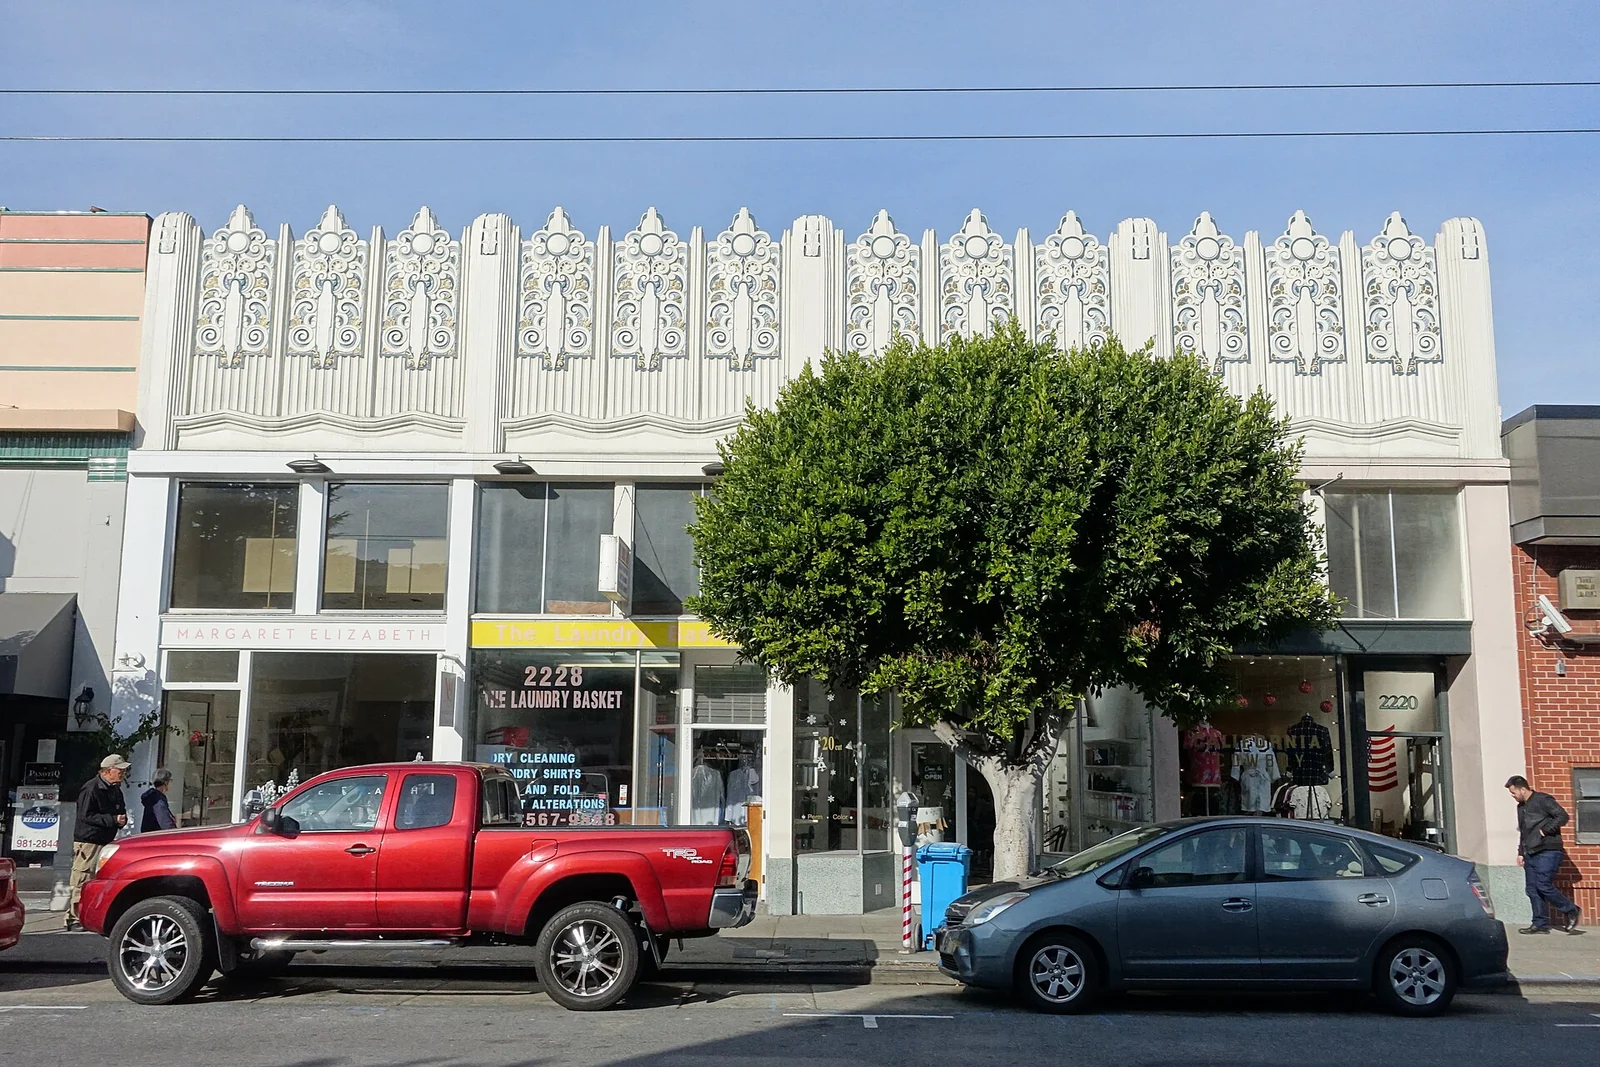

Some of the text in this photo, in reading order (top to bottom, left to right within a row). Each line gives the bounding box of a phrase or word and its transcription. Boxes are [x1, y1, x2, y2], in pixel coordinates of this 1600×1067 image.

[177, 628, 431, 641] MARGARET ELIZABETH
[495, 624, 709, 647] The Laundry Bas
[524, 666, 583, 687] 2228
[483, 690, 623, 709] THE LAUNDRY BASKET
[1378, 694, 1419, 710] 2220
[1193, 734, 1321, 749] CALIFORNIA
[520, 753, 576, 764] CLEANING
[510, 768, 581, 779] NDRY SHIRTS
[525, 785, 580, 795] AND FOLD
[532, 799, 605, 810] ALTERATIONS
[16, 839, 60, 848] 981-2844
[660, 847, 698, 859] TRD
